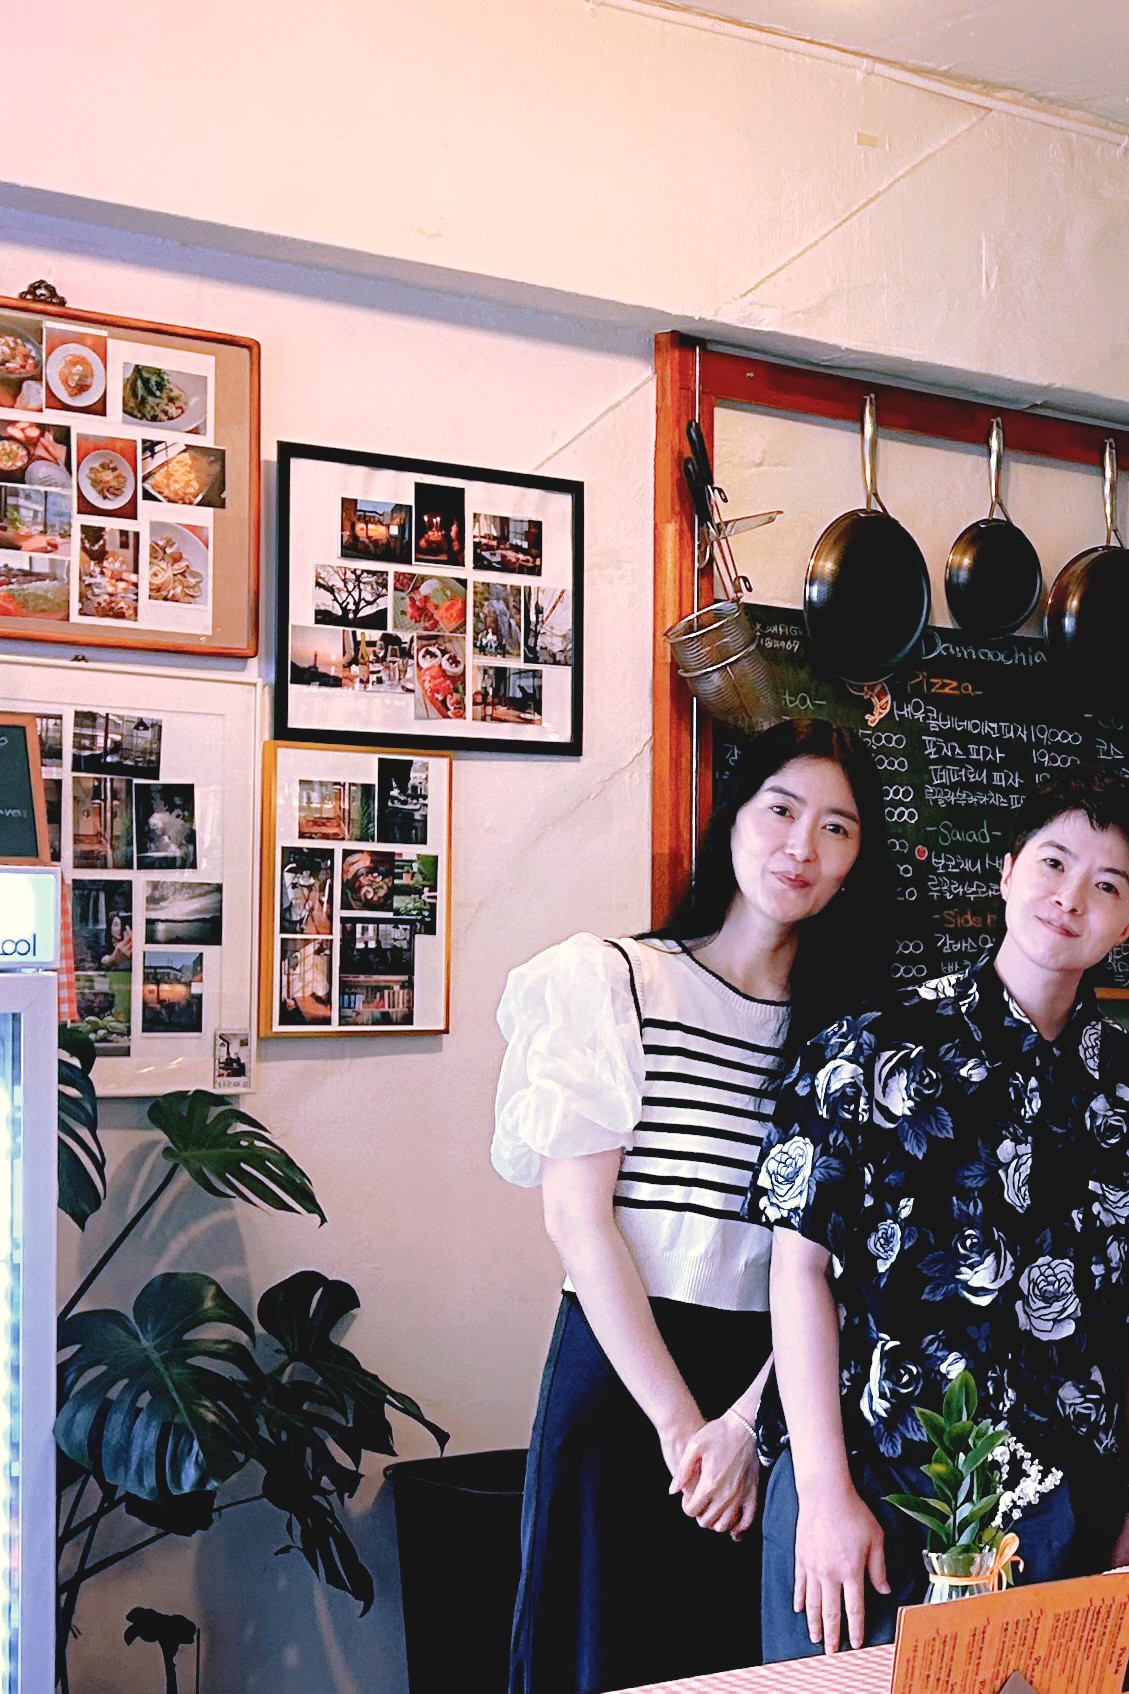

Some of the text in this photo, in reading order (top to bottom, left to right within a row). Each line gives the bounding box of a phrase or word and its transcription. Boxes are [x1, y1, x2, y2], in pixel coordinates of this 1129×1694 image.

[921, 629, 1047, 666] Damoochia
[967, 745, 1006, 764] 피자
[992, 769, 1025, 788] 피자
[0, 933, 36, 957] ool
